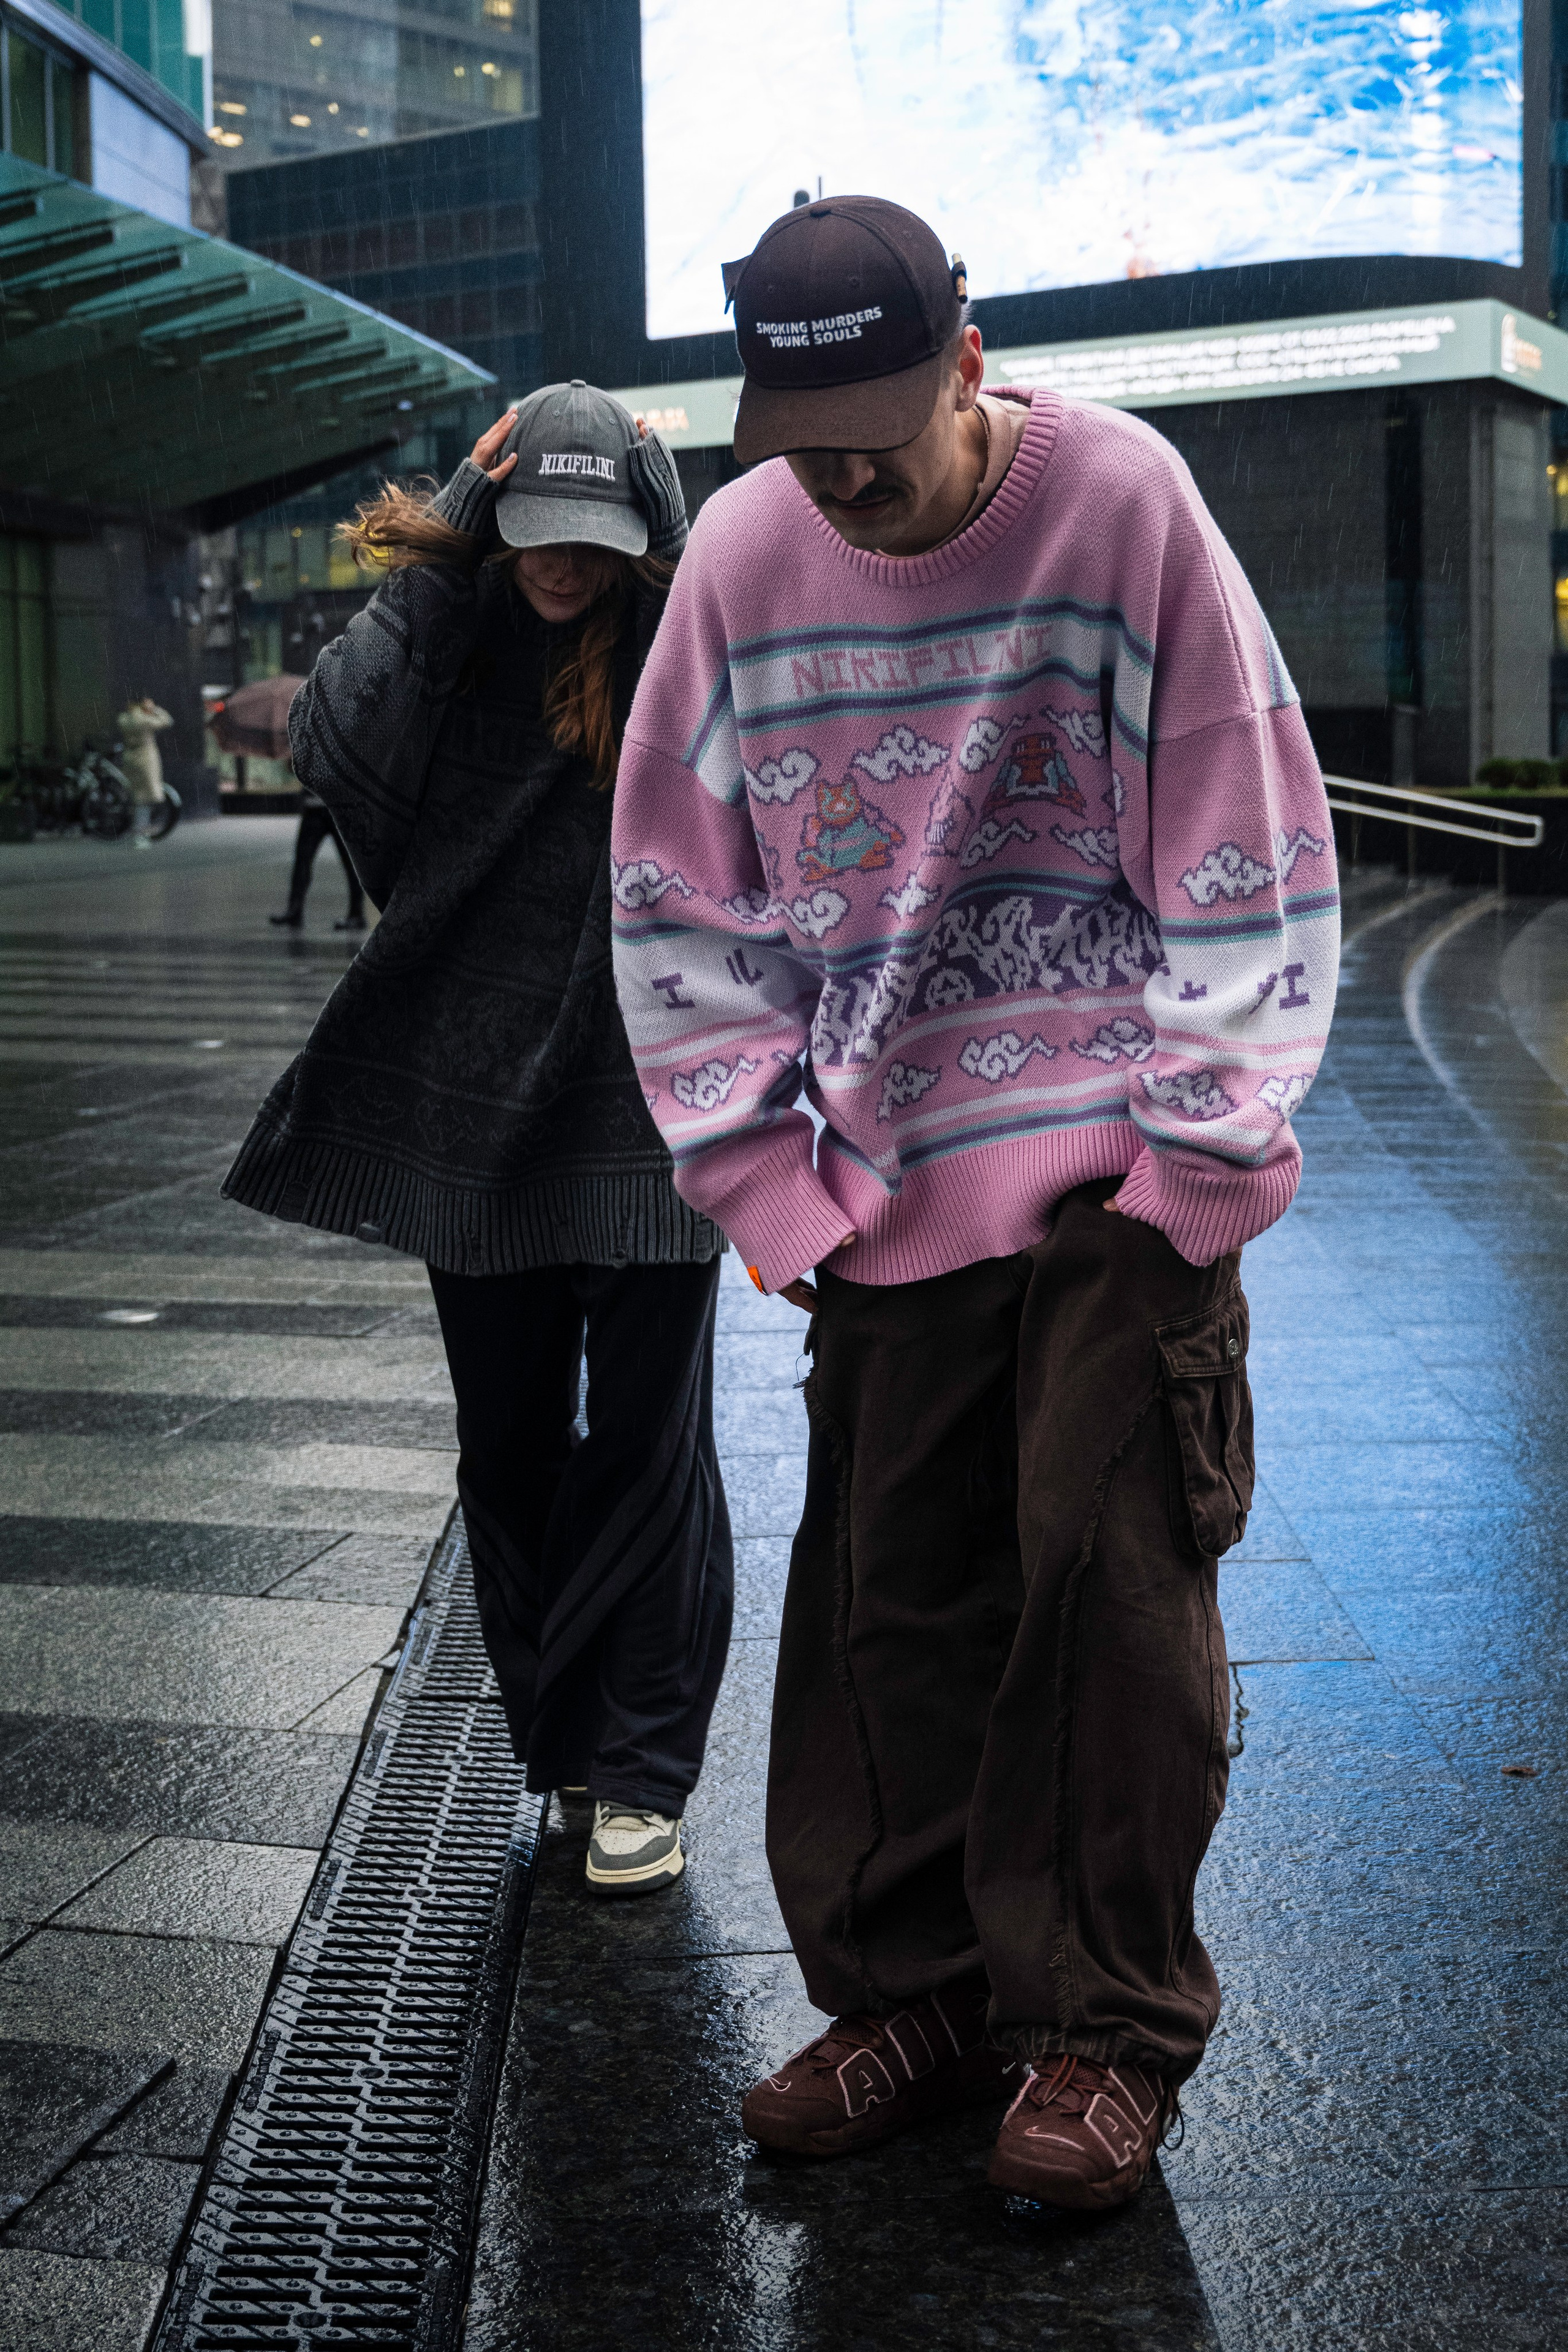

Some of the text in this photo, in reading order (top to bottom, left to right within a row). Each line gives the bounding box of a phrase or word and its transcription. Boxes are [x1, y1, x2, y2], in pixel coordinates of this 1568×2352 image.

[756, 306, 883, 334] SMOKING MURDERS
[770, 325, 862, 348] YOUNG SOULS
[538, 453, 616, 481] NIKIFILINI
[791, 625, 1052, 697] NIKIFILNI
